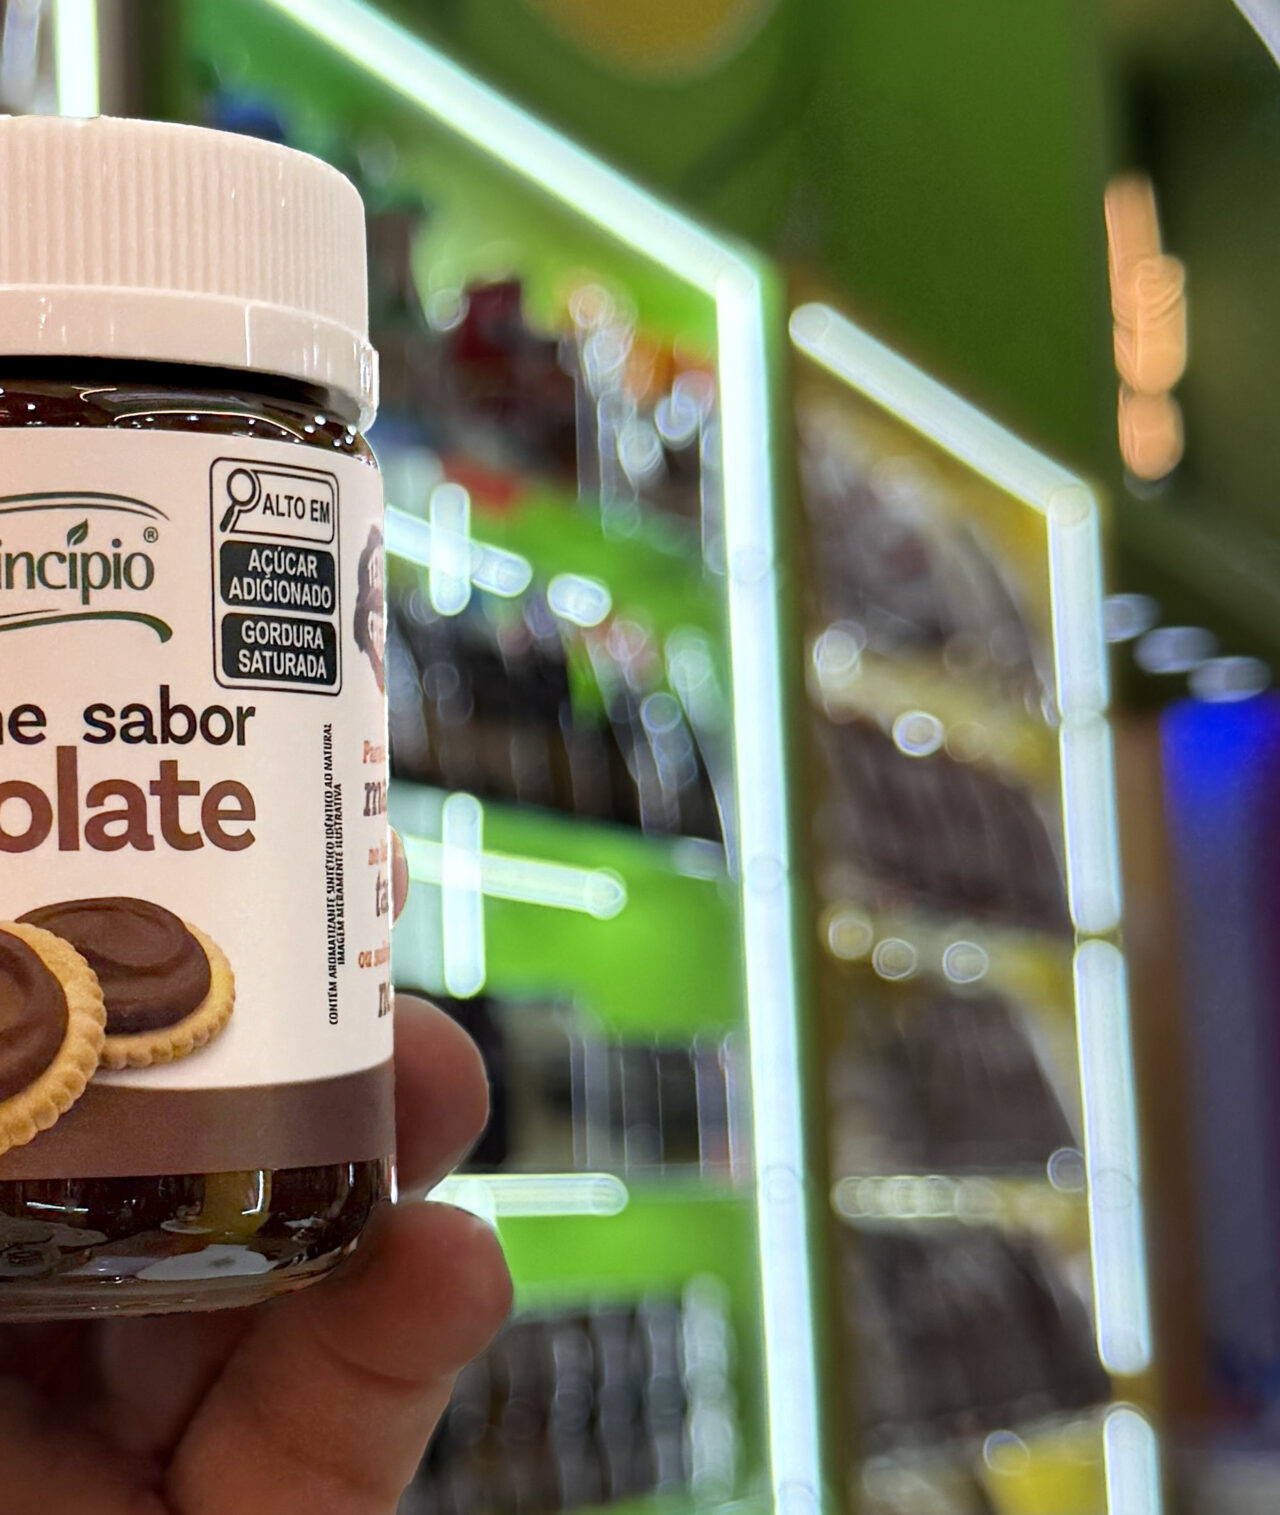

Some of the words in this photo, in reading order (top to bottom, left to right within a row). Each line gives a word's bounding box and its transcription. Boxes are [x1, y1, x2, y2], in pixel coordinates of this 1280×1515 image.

[262, 493, 306, 521] ALTO
[310, 499, 331, 525] EM
[248, 546, 318, 580] AÇÚCAR
[228, 577, 332, 610] ADICIONADO
[241, 619, 325, 651] GORDURA
[238, 649, 328, 680] SATURADA
[81, 684, 257, 747] sabor
[322, 723, 332, 771] NATURAL
[333, 783, 343, 848] ILUSTRATIVA
[334, 851, 344, 918] MERAMENTE
[336, 921, 345, 965] IMAGEM
